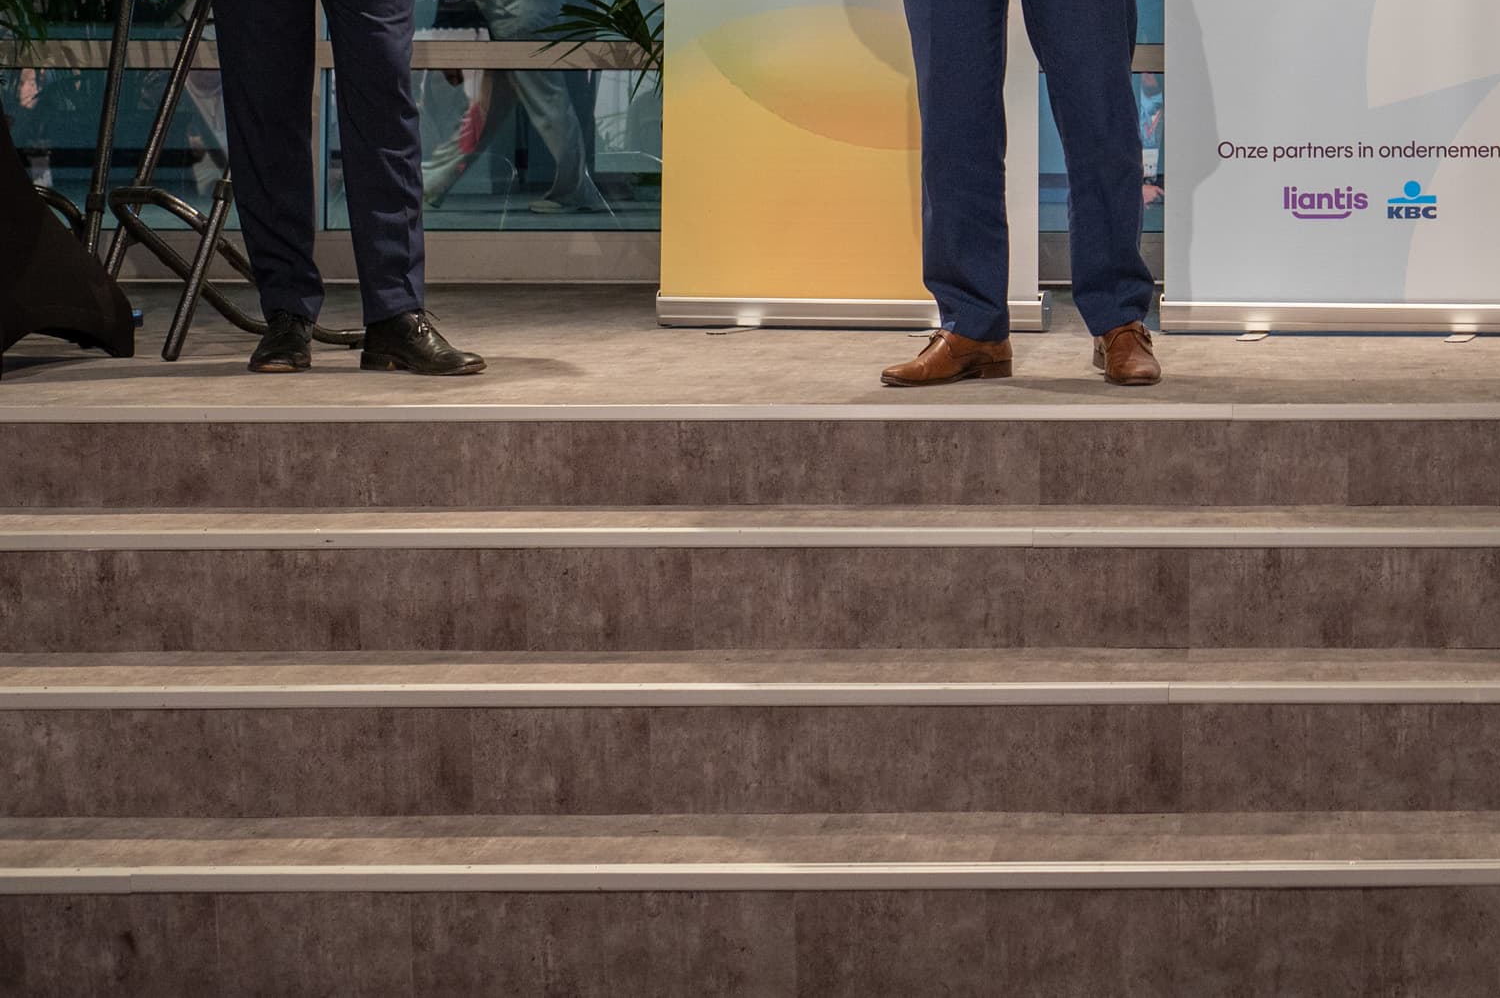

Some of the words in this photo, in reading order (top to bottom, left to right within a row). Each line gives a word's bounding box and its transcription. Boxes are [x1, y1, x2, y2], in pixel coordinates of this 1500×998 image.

[1218, 142, 1268, 159] Onze
[1273, 142, 1353, 162] partners
[1358, 142, 1374, 158] in
[1379, 141, 1500, 159] ondernemen
[1283, 186, 1368, 211] liantis
[1387, 206, 1437, 219] KBC
